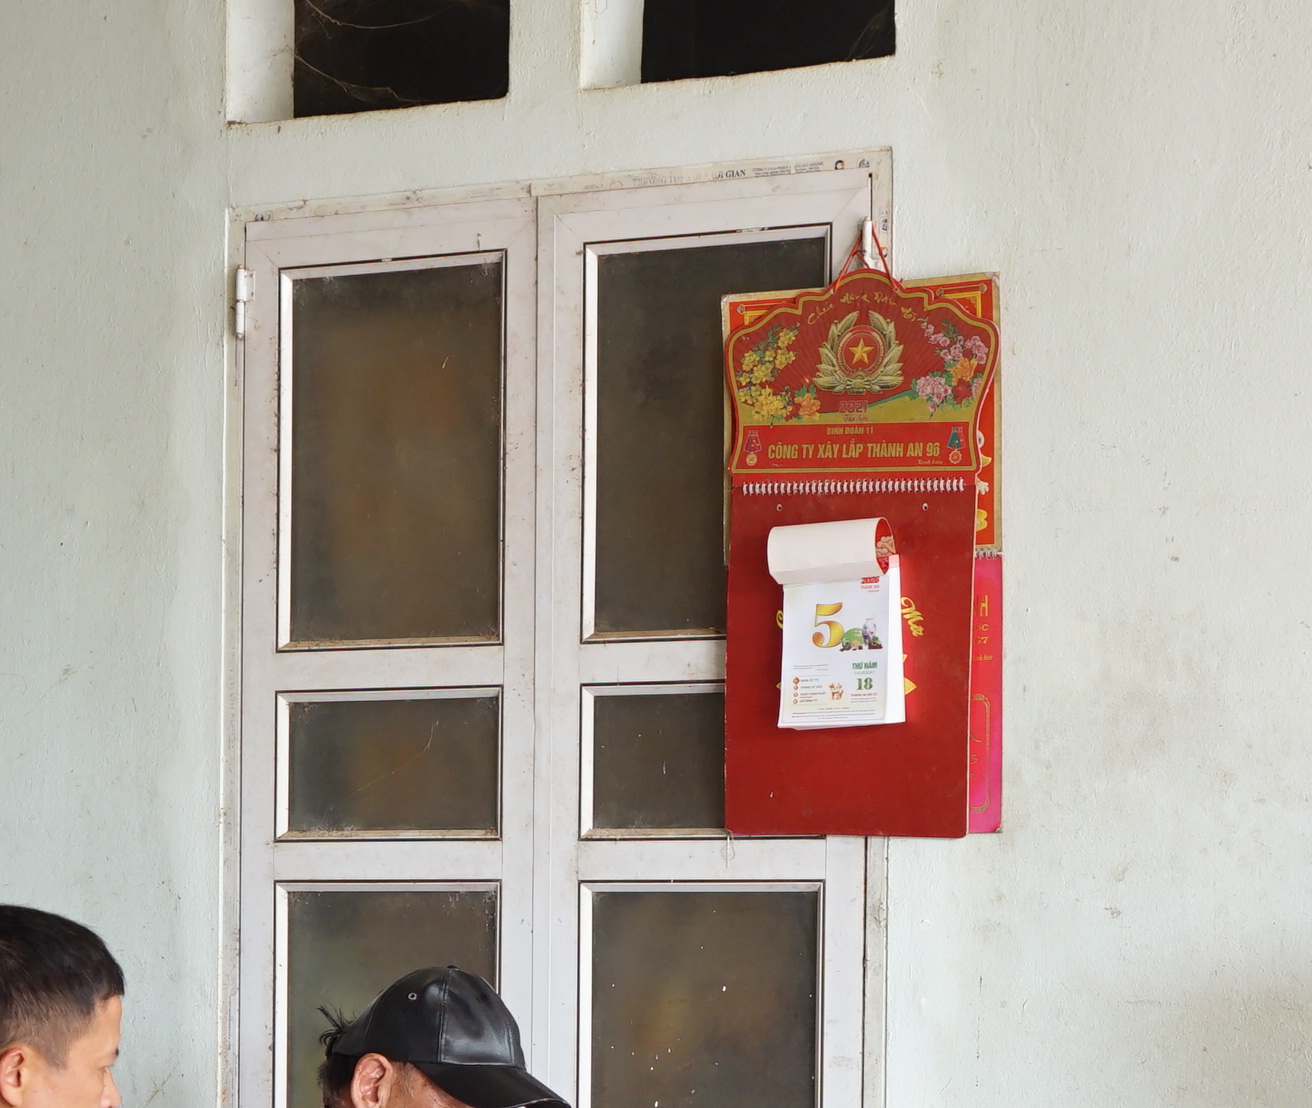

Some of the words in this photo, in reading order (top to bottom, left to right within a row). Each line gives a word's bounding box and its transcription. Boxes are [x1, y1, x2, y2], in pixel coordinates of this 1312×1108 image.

[866, 426, 874, 435] 11
[767, 441, 798, 459] CÔNG
[801, 444, 815, 459] TY
[817, 441, 839, 459] XÂY
[842, 438, 863, 458] LẮP
[866, 440, 904, 458] THÀNH
[906, 442, 923, 457] AN
[926, 442, 941, 457] 96
[812, 602, 844, 648] 5
[851, 661, 864, 670] THỨ
[864, 661, 878, 670] NĂM
[856, 677, 873, 690] 18
